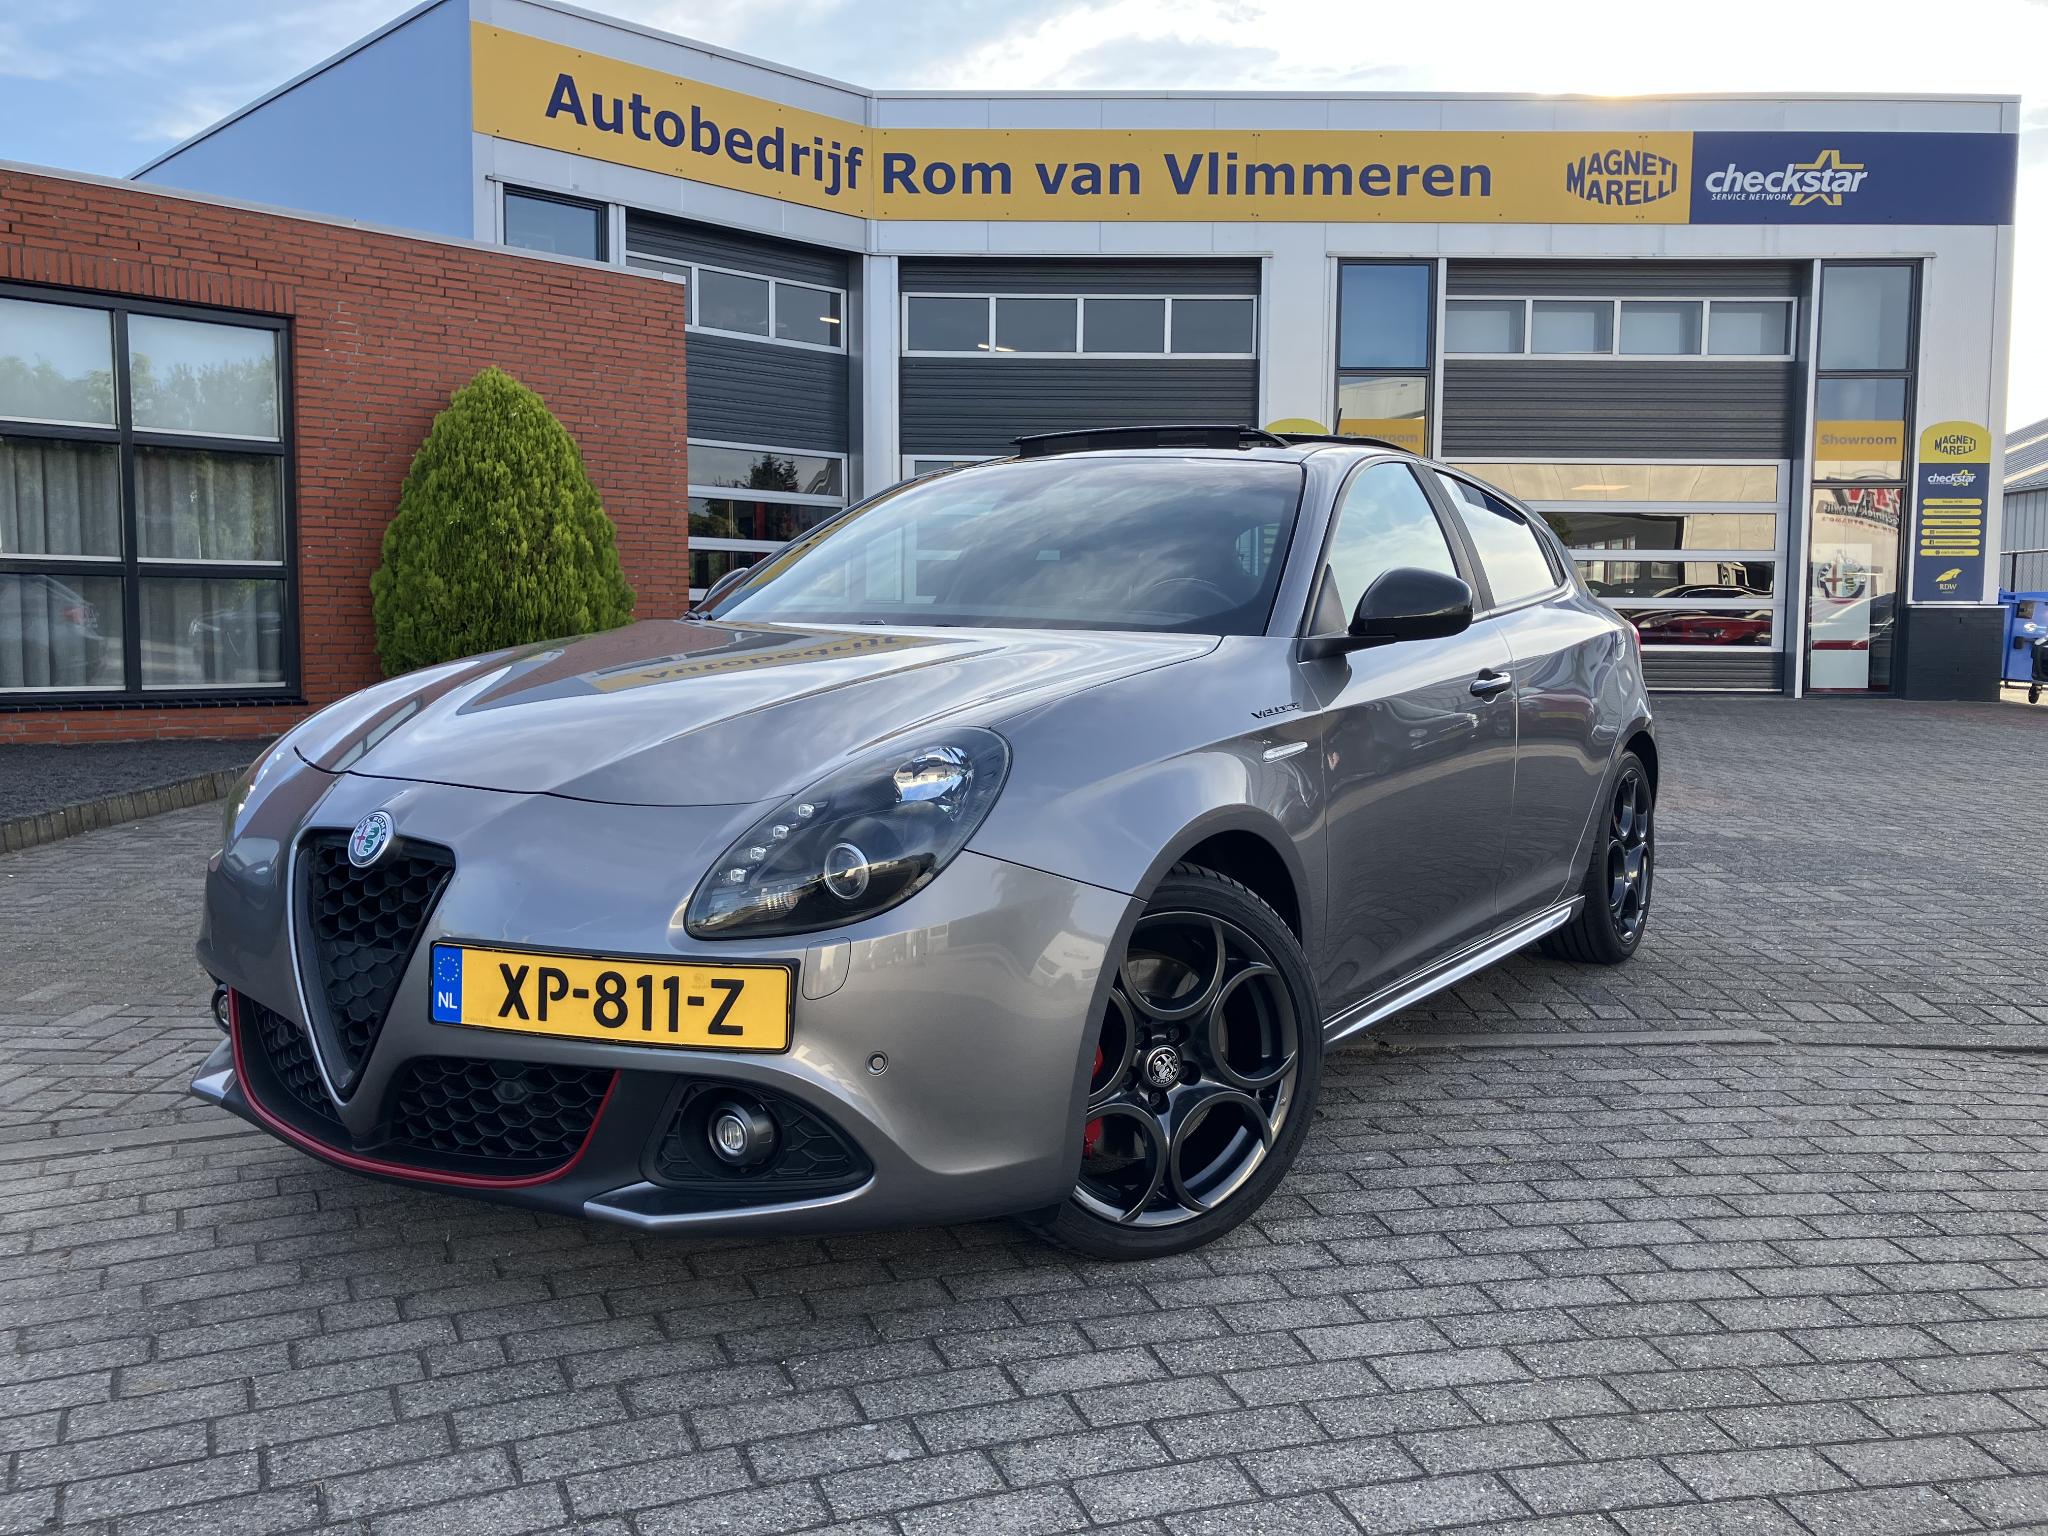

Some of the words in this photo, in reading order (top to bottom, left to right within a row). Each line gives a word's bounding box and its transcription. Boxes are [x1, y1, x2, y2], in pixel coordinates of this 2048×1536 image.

[545, 72, 864, 196] Autobedrijf
[883, 152, 1012, 195] Rom
[1035, 162, 1141, 195] van
[1163, 151, 1491, 197] Vlimmeren
[1566, 149, 1678, 187] MAGNETI
[1705, 164, 1868, 193] checkstar
[1566, 173, 1678, 206] MARELLI
[1711, 193, 1747, 201] SERVICE
[1749, 193, 1793, 201] NETWORK
[1821, 434, 1897, 445] Showroom
[1934, 434, 1977, 448] MAGNETI
[1934, 443, 1977, 456] MARELLI
[1927, 473, 1977, 483] checkstar
[438, 991, 458, 1010] NL
[497, 963, 745, 1036] XP-811-Z
